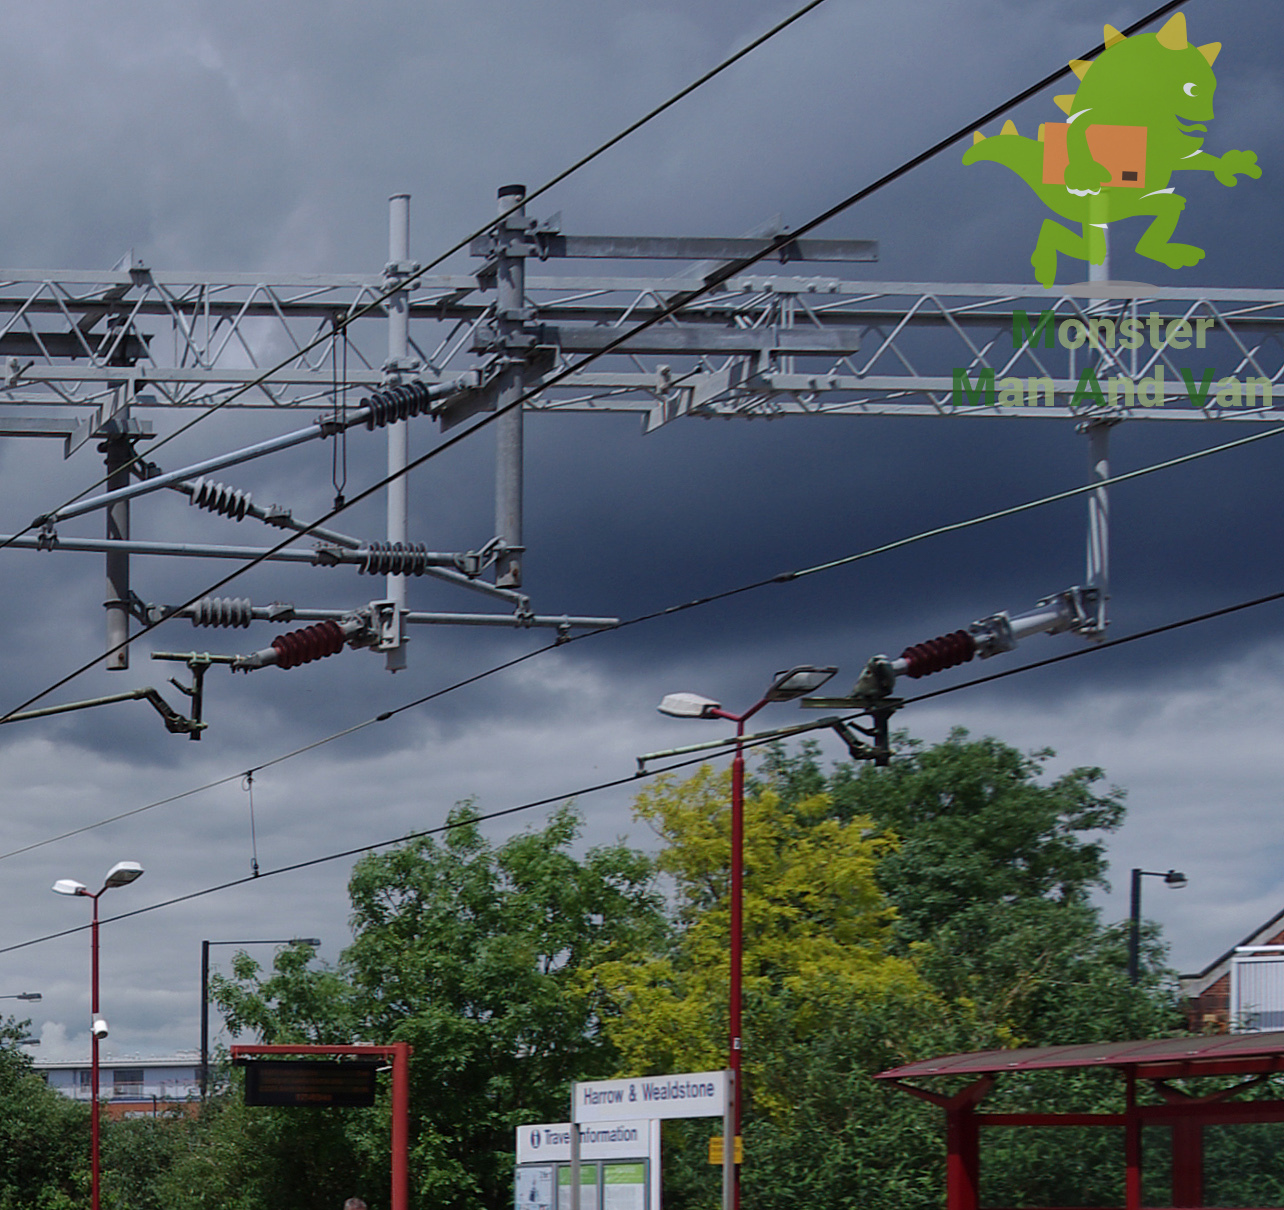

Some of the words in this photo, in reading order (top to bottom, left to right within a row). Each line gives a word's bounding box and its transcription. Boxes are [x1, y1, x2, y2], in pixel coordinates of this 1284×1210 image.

[584, 1087, 624, 1105] Harrow
[629, 1084, 637, 1102] &
[642, 1081, 715, 1101] Wealdstone
[544, 1128, 570, 1145] Trave
